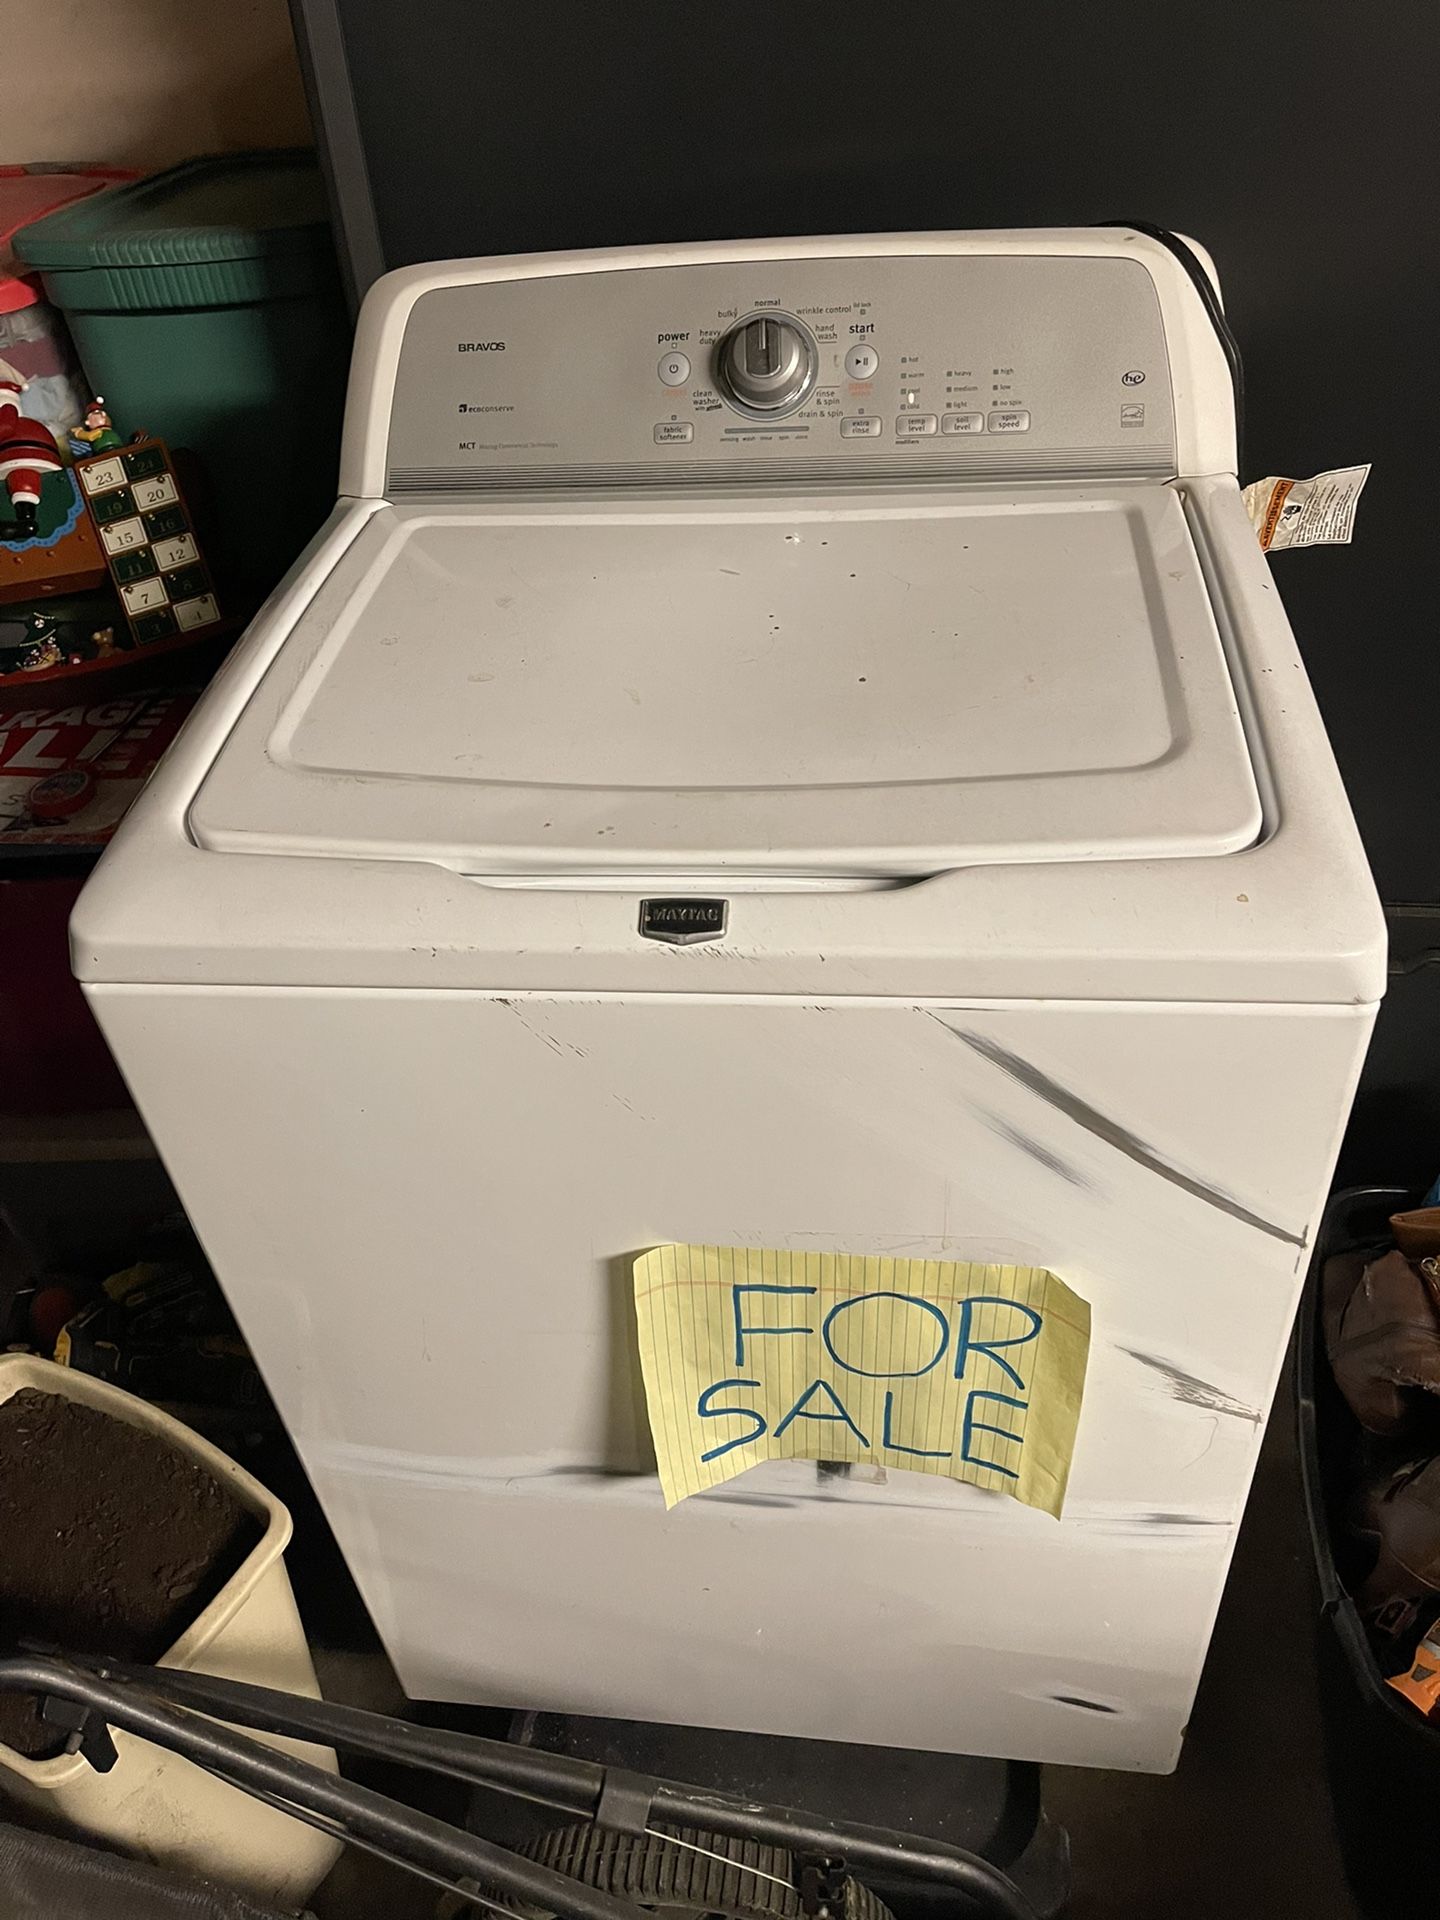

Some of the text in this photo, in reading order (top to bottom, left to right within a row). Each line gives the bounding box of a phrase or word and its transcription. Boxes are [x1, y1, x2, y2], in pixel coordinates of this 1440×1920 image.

[755, 299, 781, 307] normal
[718, 310, 738, 319] bulky
[797, 306, 852, 315] wrinkle control
[815, 324, 835, 332] hand
[849, 323, 875, 334] start
[657, 332, 690, 344] power
[700, 330, 721, 338] heavy
[818, 332, 838, 340] wash
[700, 337, 716, 345] duty
[458, 342, 506, 352] BRAVOS
[824, 398, 840, 406] spin
[798, 410, 818, 418] drain
[828, 410, 843, 418] spin
[954, 423, 970, 431] level
[998, 421, 1020, 429] speed
[459, 442, 476, 450] MCT
[95, 472, 114, 486] 23
[147, 490, 165, 502] 20
[107, 503, 123, 516] 19
[159, 519, 175, 532] 16
[117, 533, 134, 546] 15
[168, 550, 185, 562] 12
[128, 563, 143, 576] 11
[141, 594, 149, 605] 7
[0, 699, 174, 730] RAGE
[653, 907, 718, 921] MAYTAG
[733, 1284, 1042, 1389] FOR
[698, 1379, 1028, 1479] SALE
